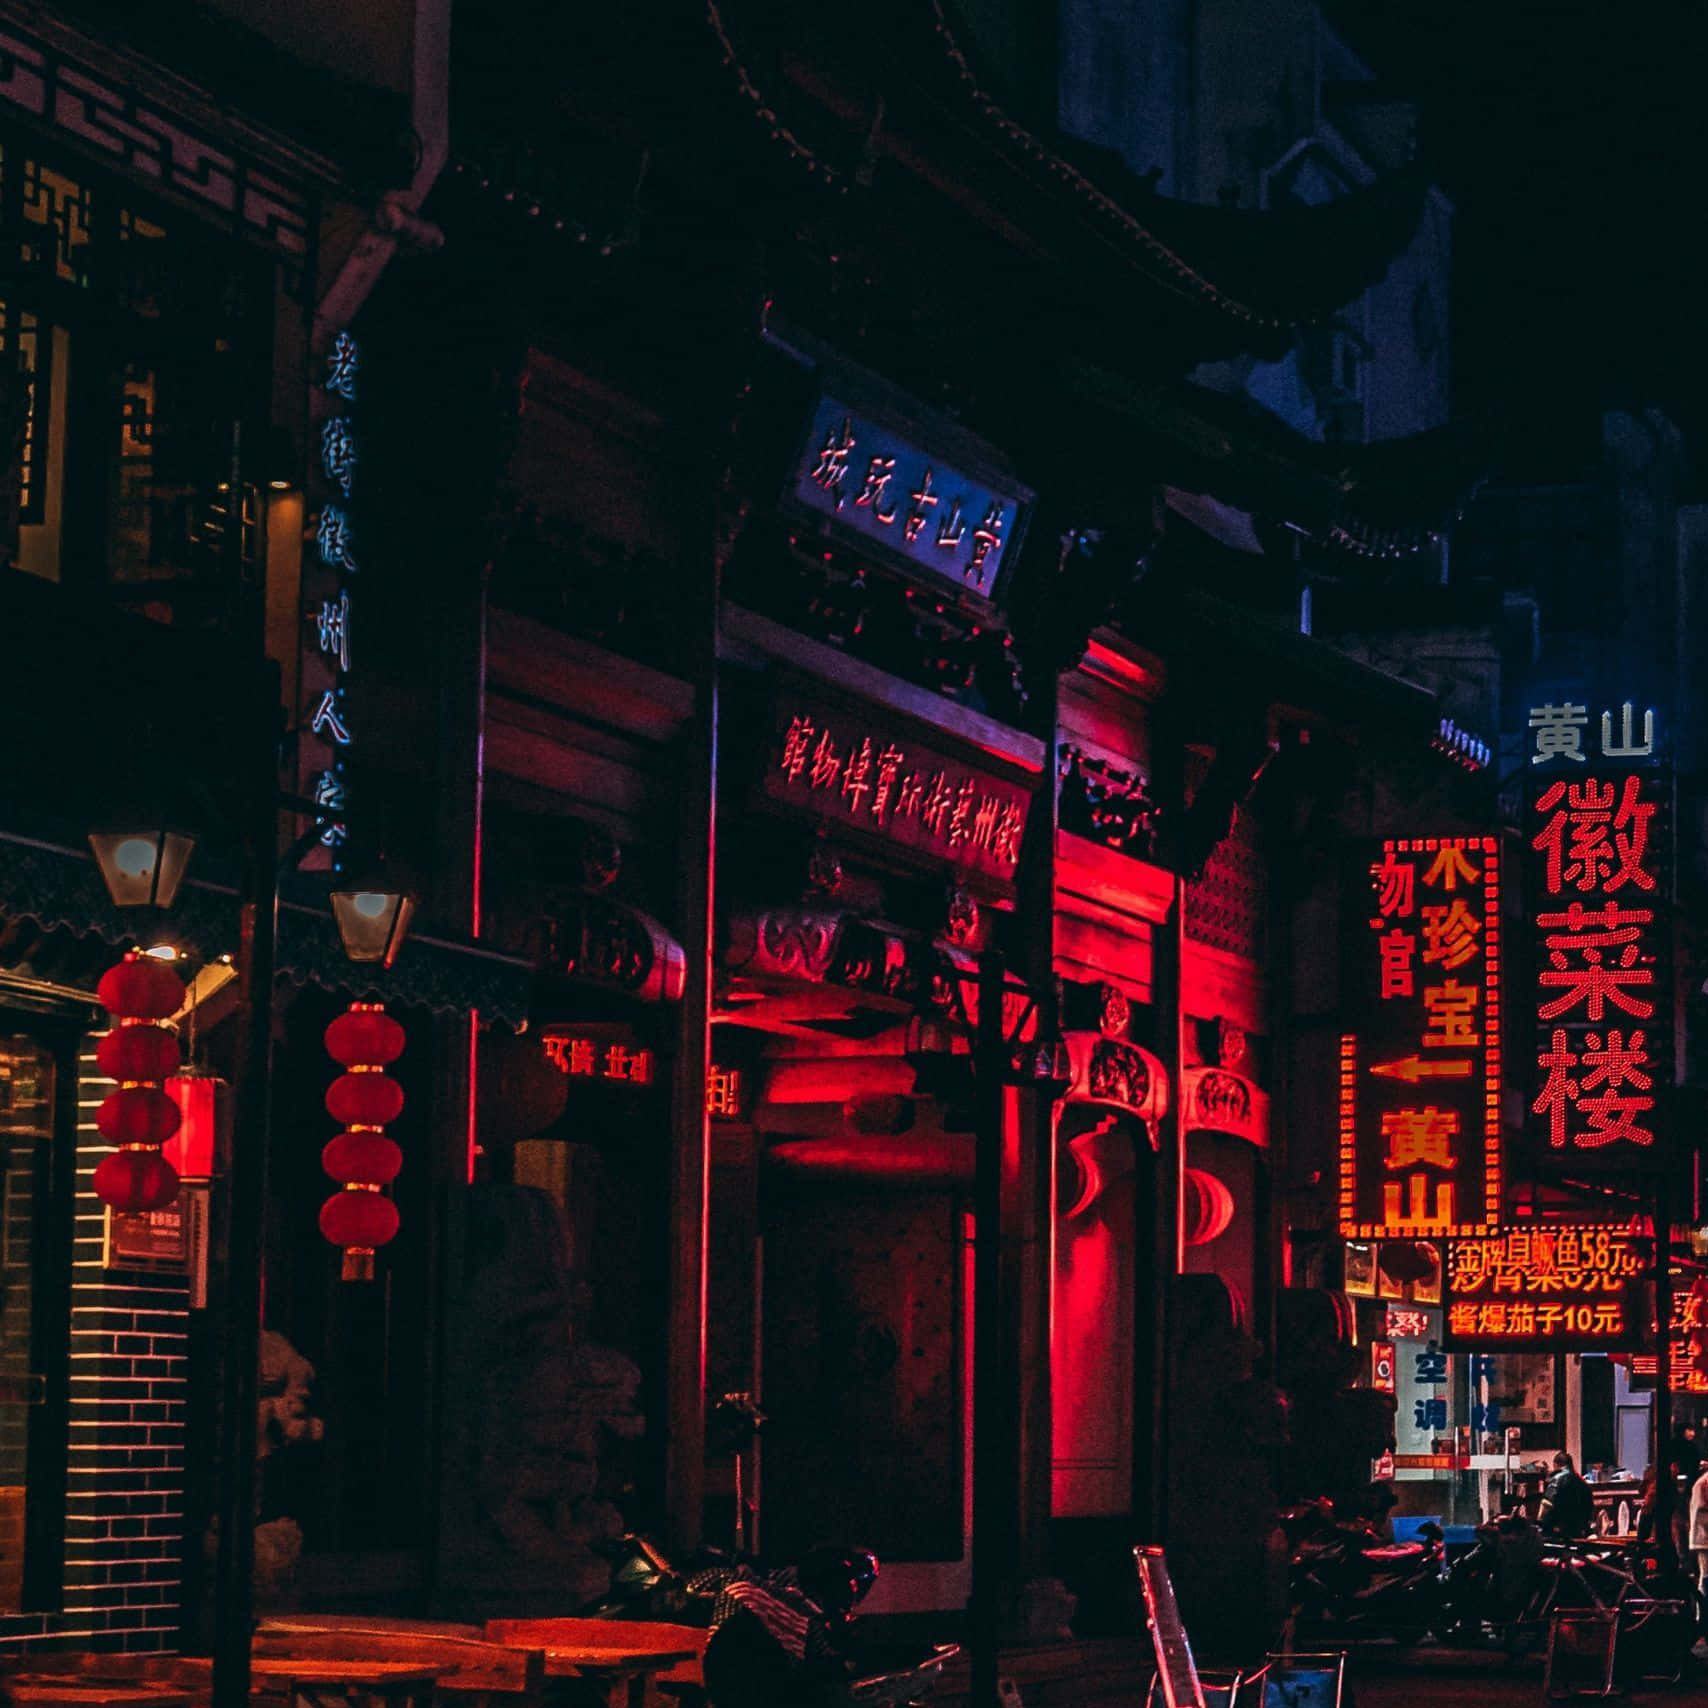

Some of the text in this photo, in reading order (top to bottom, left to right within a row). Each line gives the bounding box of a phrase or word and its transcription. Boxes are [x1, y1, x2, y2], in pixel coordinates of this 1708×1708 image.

[1528, 701, 1655, 766] 黄山
[1531, 774, 1657, 1150] 徽菜楼
[1380, 1105, 1459, 1229] 黄山
[1449, 1302, 1625, 1336] 酱爆茄子10元
